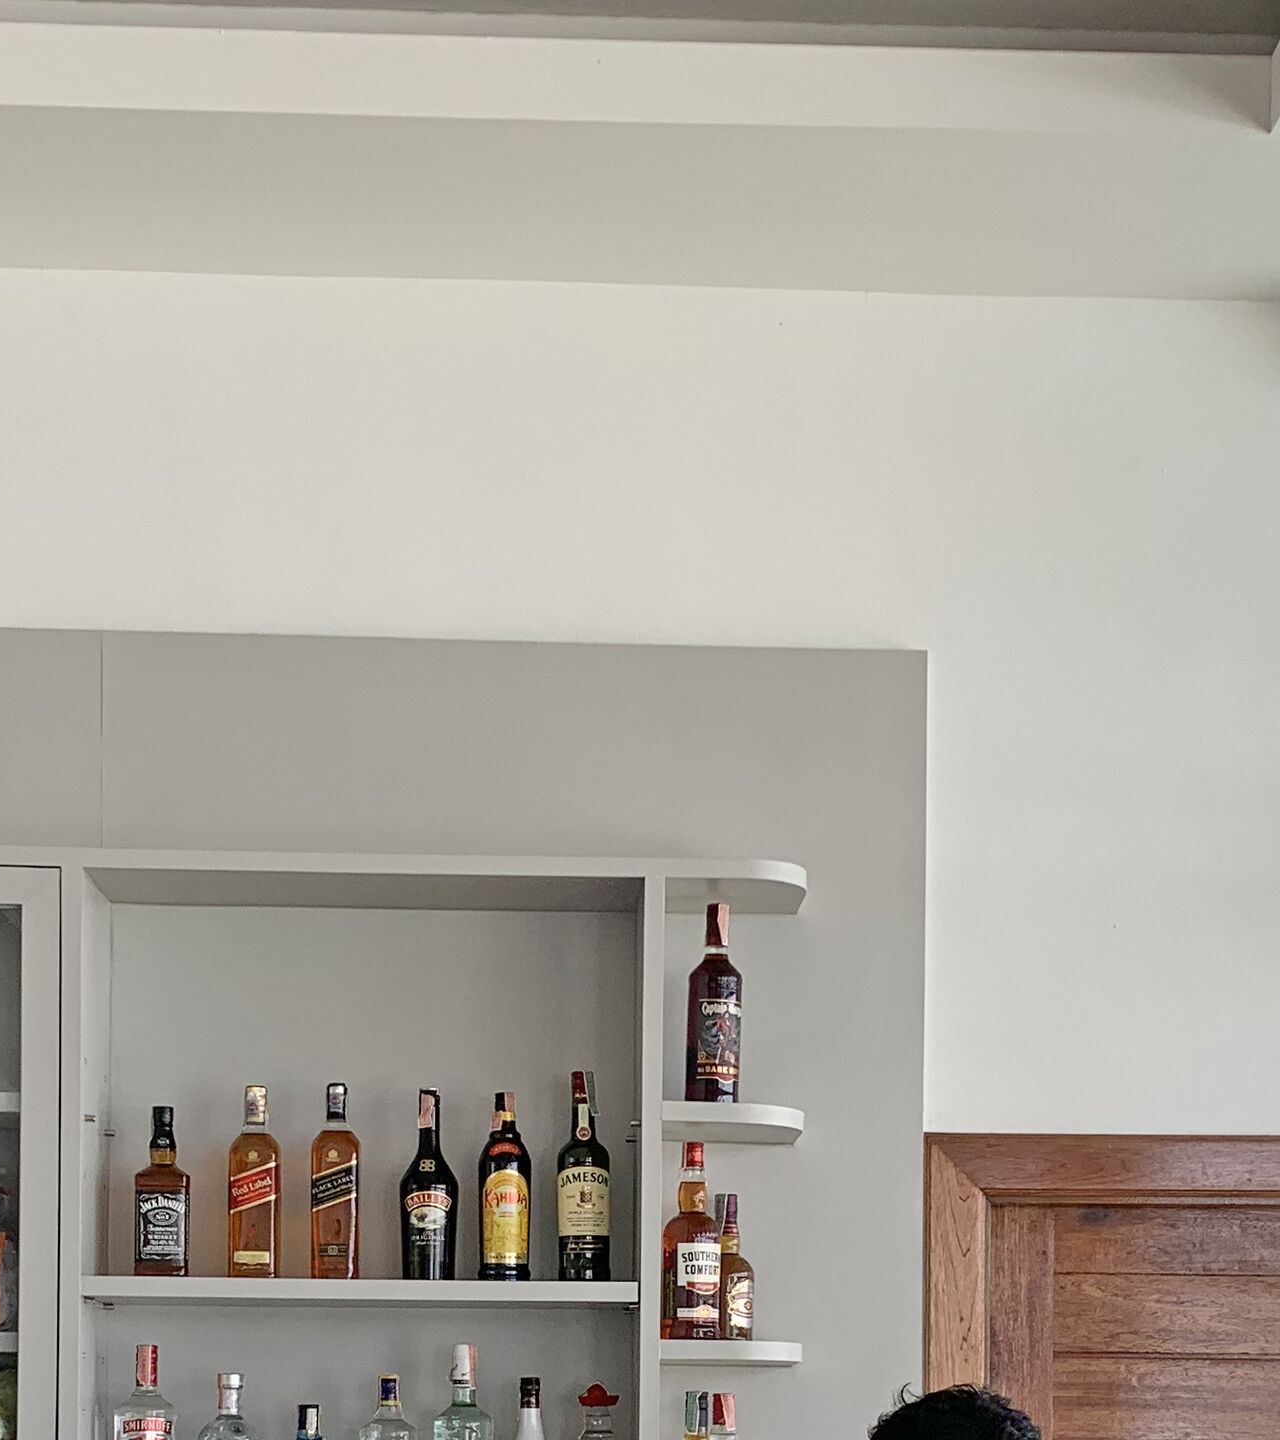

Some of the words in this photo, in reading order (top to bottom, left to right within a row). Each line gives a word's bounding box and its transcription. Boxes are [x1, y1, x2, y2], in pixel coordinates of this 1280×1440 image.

[232, 1183, 248, 1198] Red
[249, 1176, 273, 1193] Label
[560, 1172, 608, 1188] JAMESON
[139, 1199, 158, 1214] JACK
[407, 1194, 448, 1207] BAILEYS
[124, 1419, 172, 1433] SMIRNOFF
